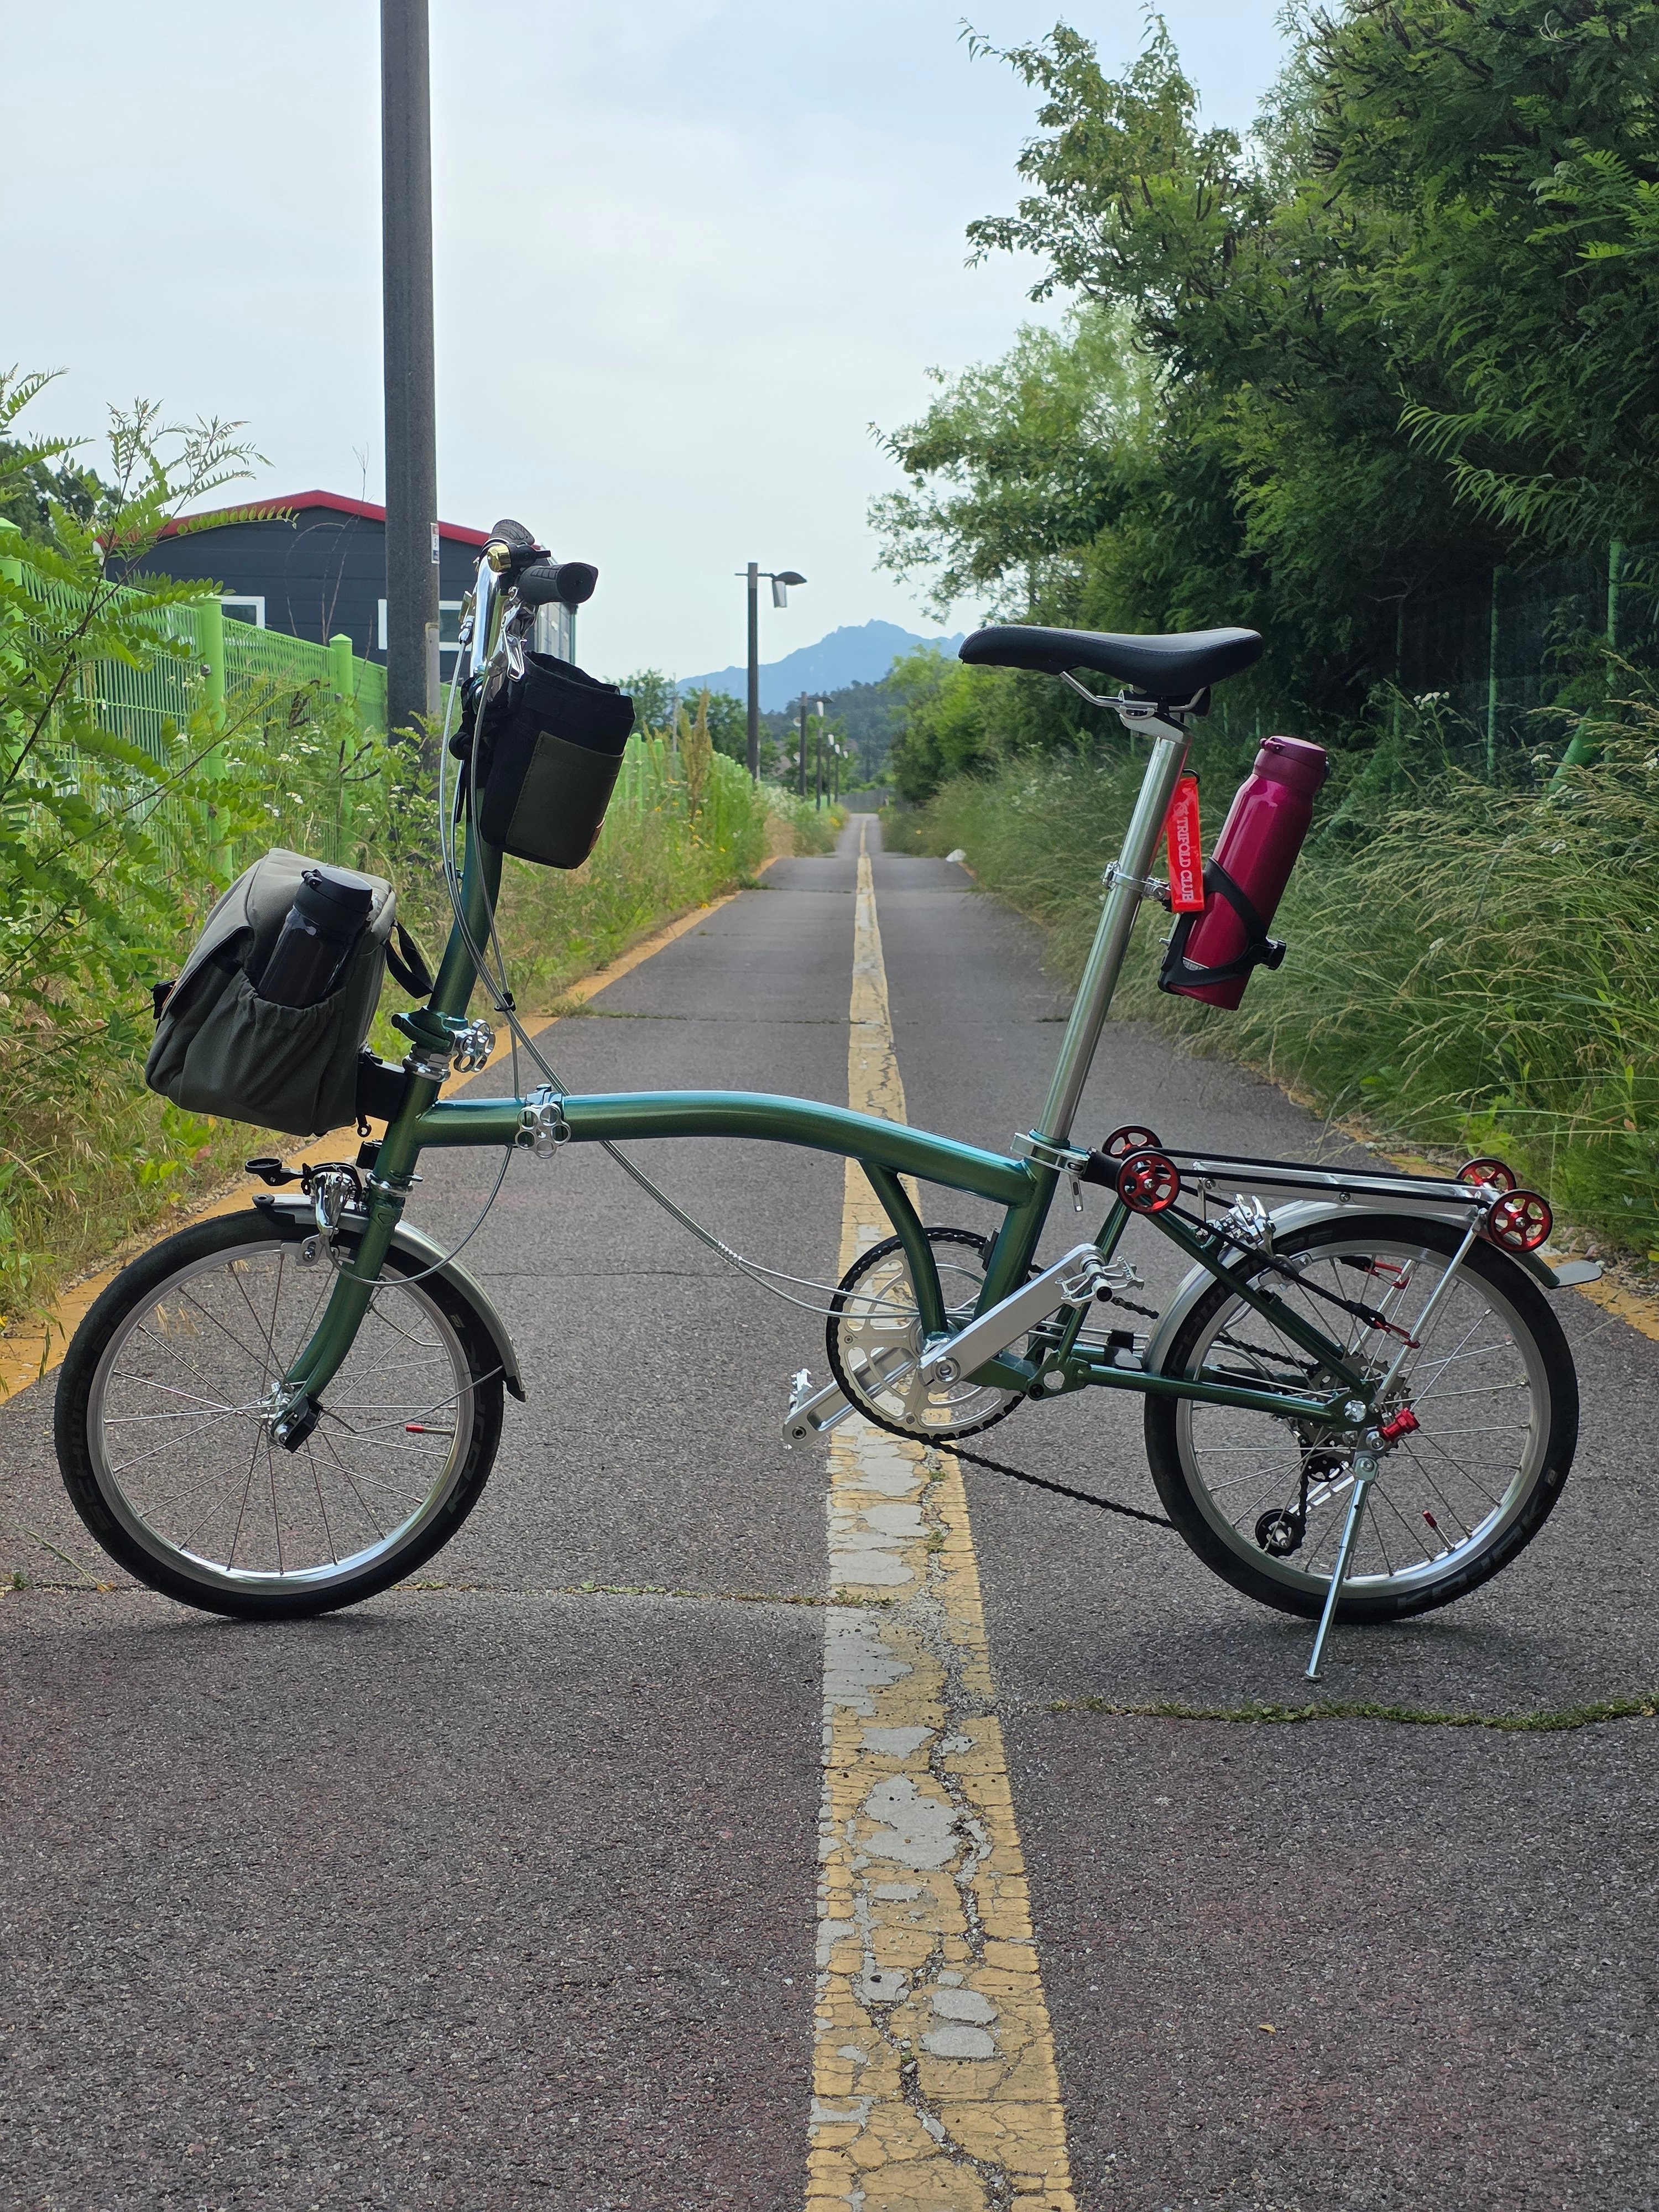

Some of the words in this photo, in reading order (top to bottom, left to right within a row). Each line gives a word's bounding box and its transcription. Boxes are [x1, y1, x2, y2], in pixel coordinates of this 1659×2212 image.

[1176, 817, 1191, 868] TRIFOLD
[1181, 870, 1194, 901] CLUB
[69, 1300, 131, 1531] SCHWALBE
[1397, 1494, 1541, 1610] KOJAK
